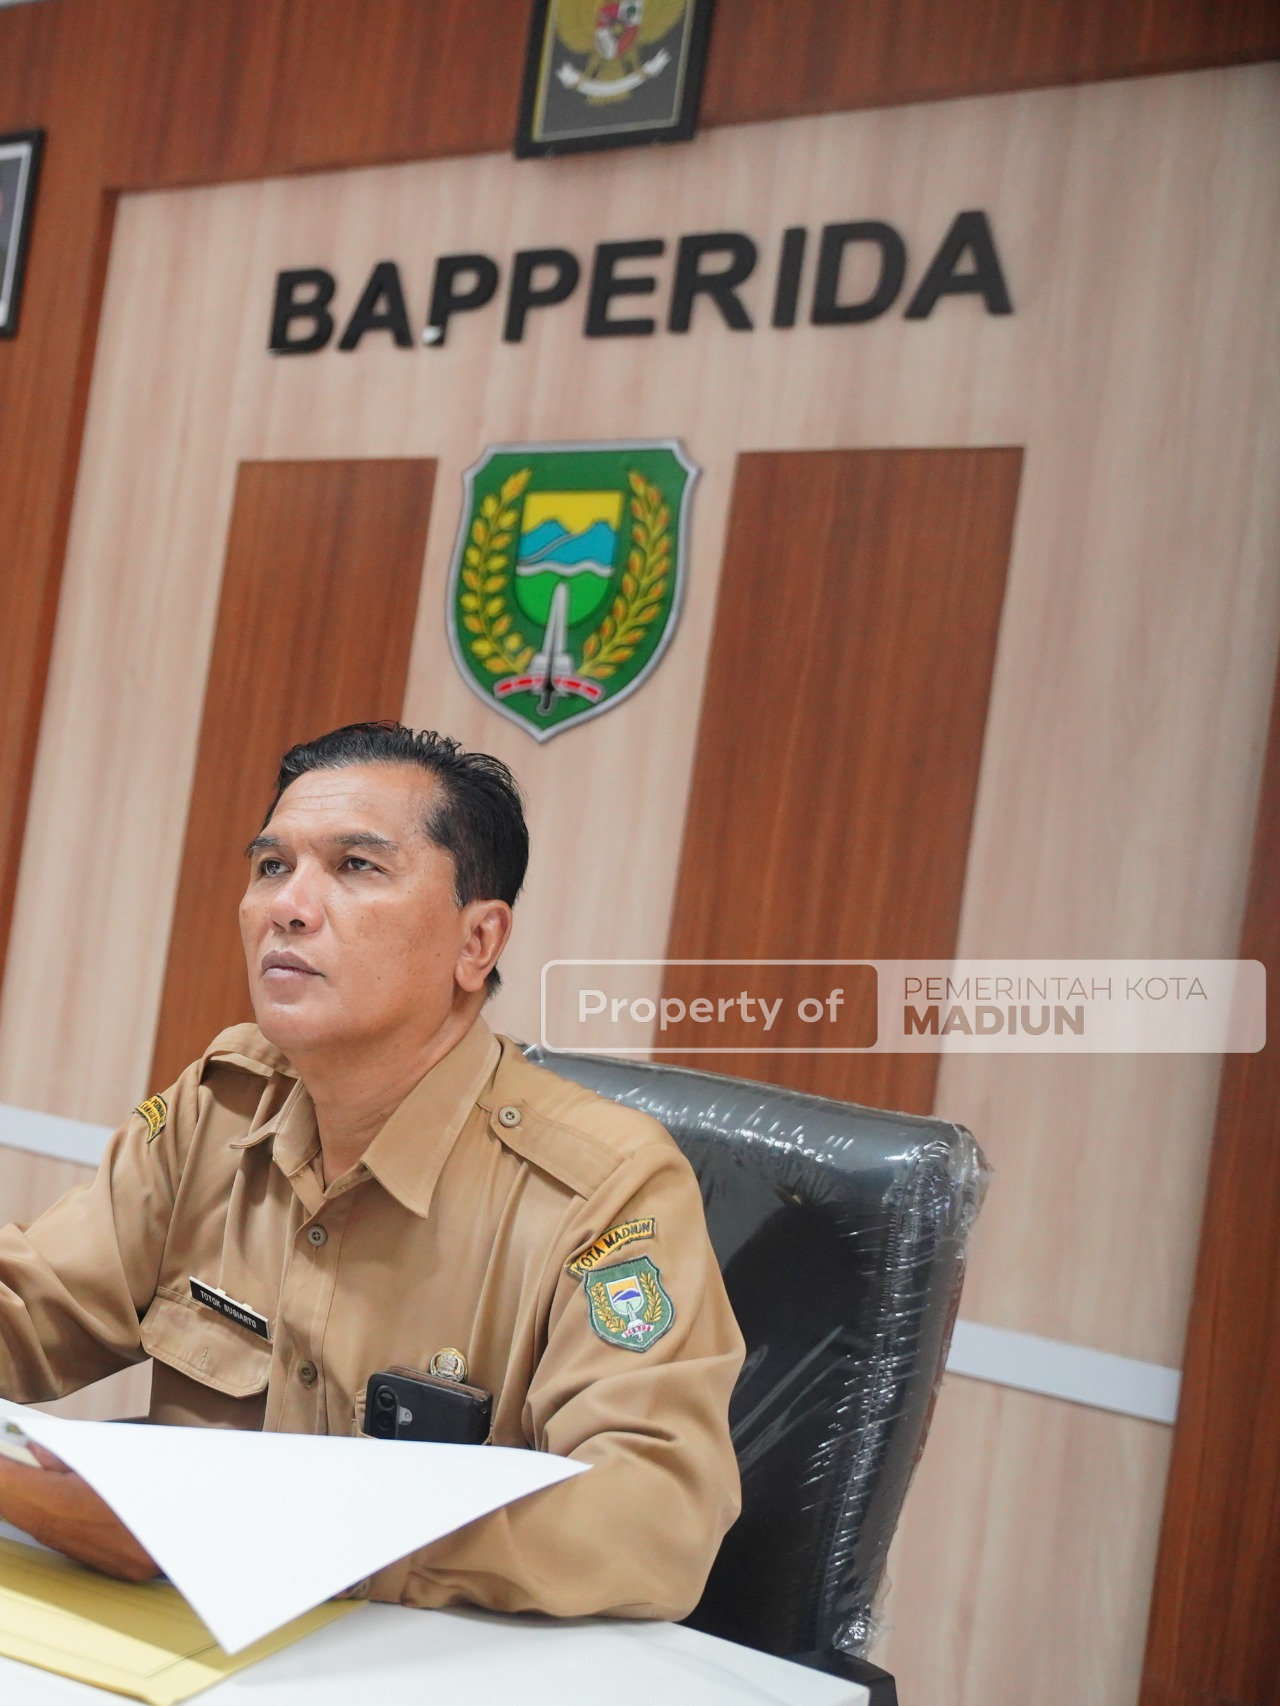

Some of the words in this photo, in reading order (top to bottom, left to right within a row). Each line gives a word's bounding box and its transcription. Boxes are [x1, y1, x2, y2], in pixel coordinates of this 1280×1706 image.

[268, 210, 1013, 355] BAPPERIDA
[572, 1244, 606, 1272] KOTA
[602, 1222, 651, 1249] MADIUN
[200, 1290, 221, 1308] TOTOK
